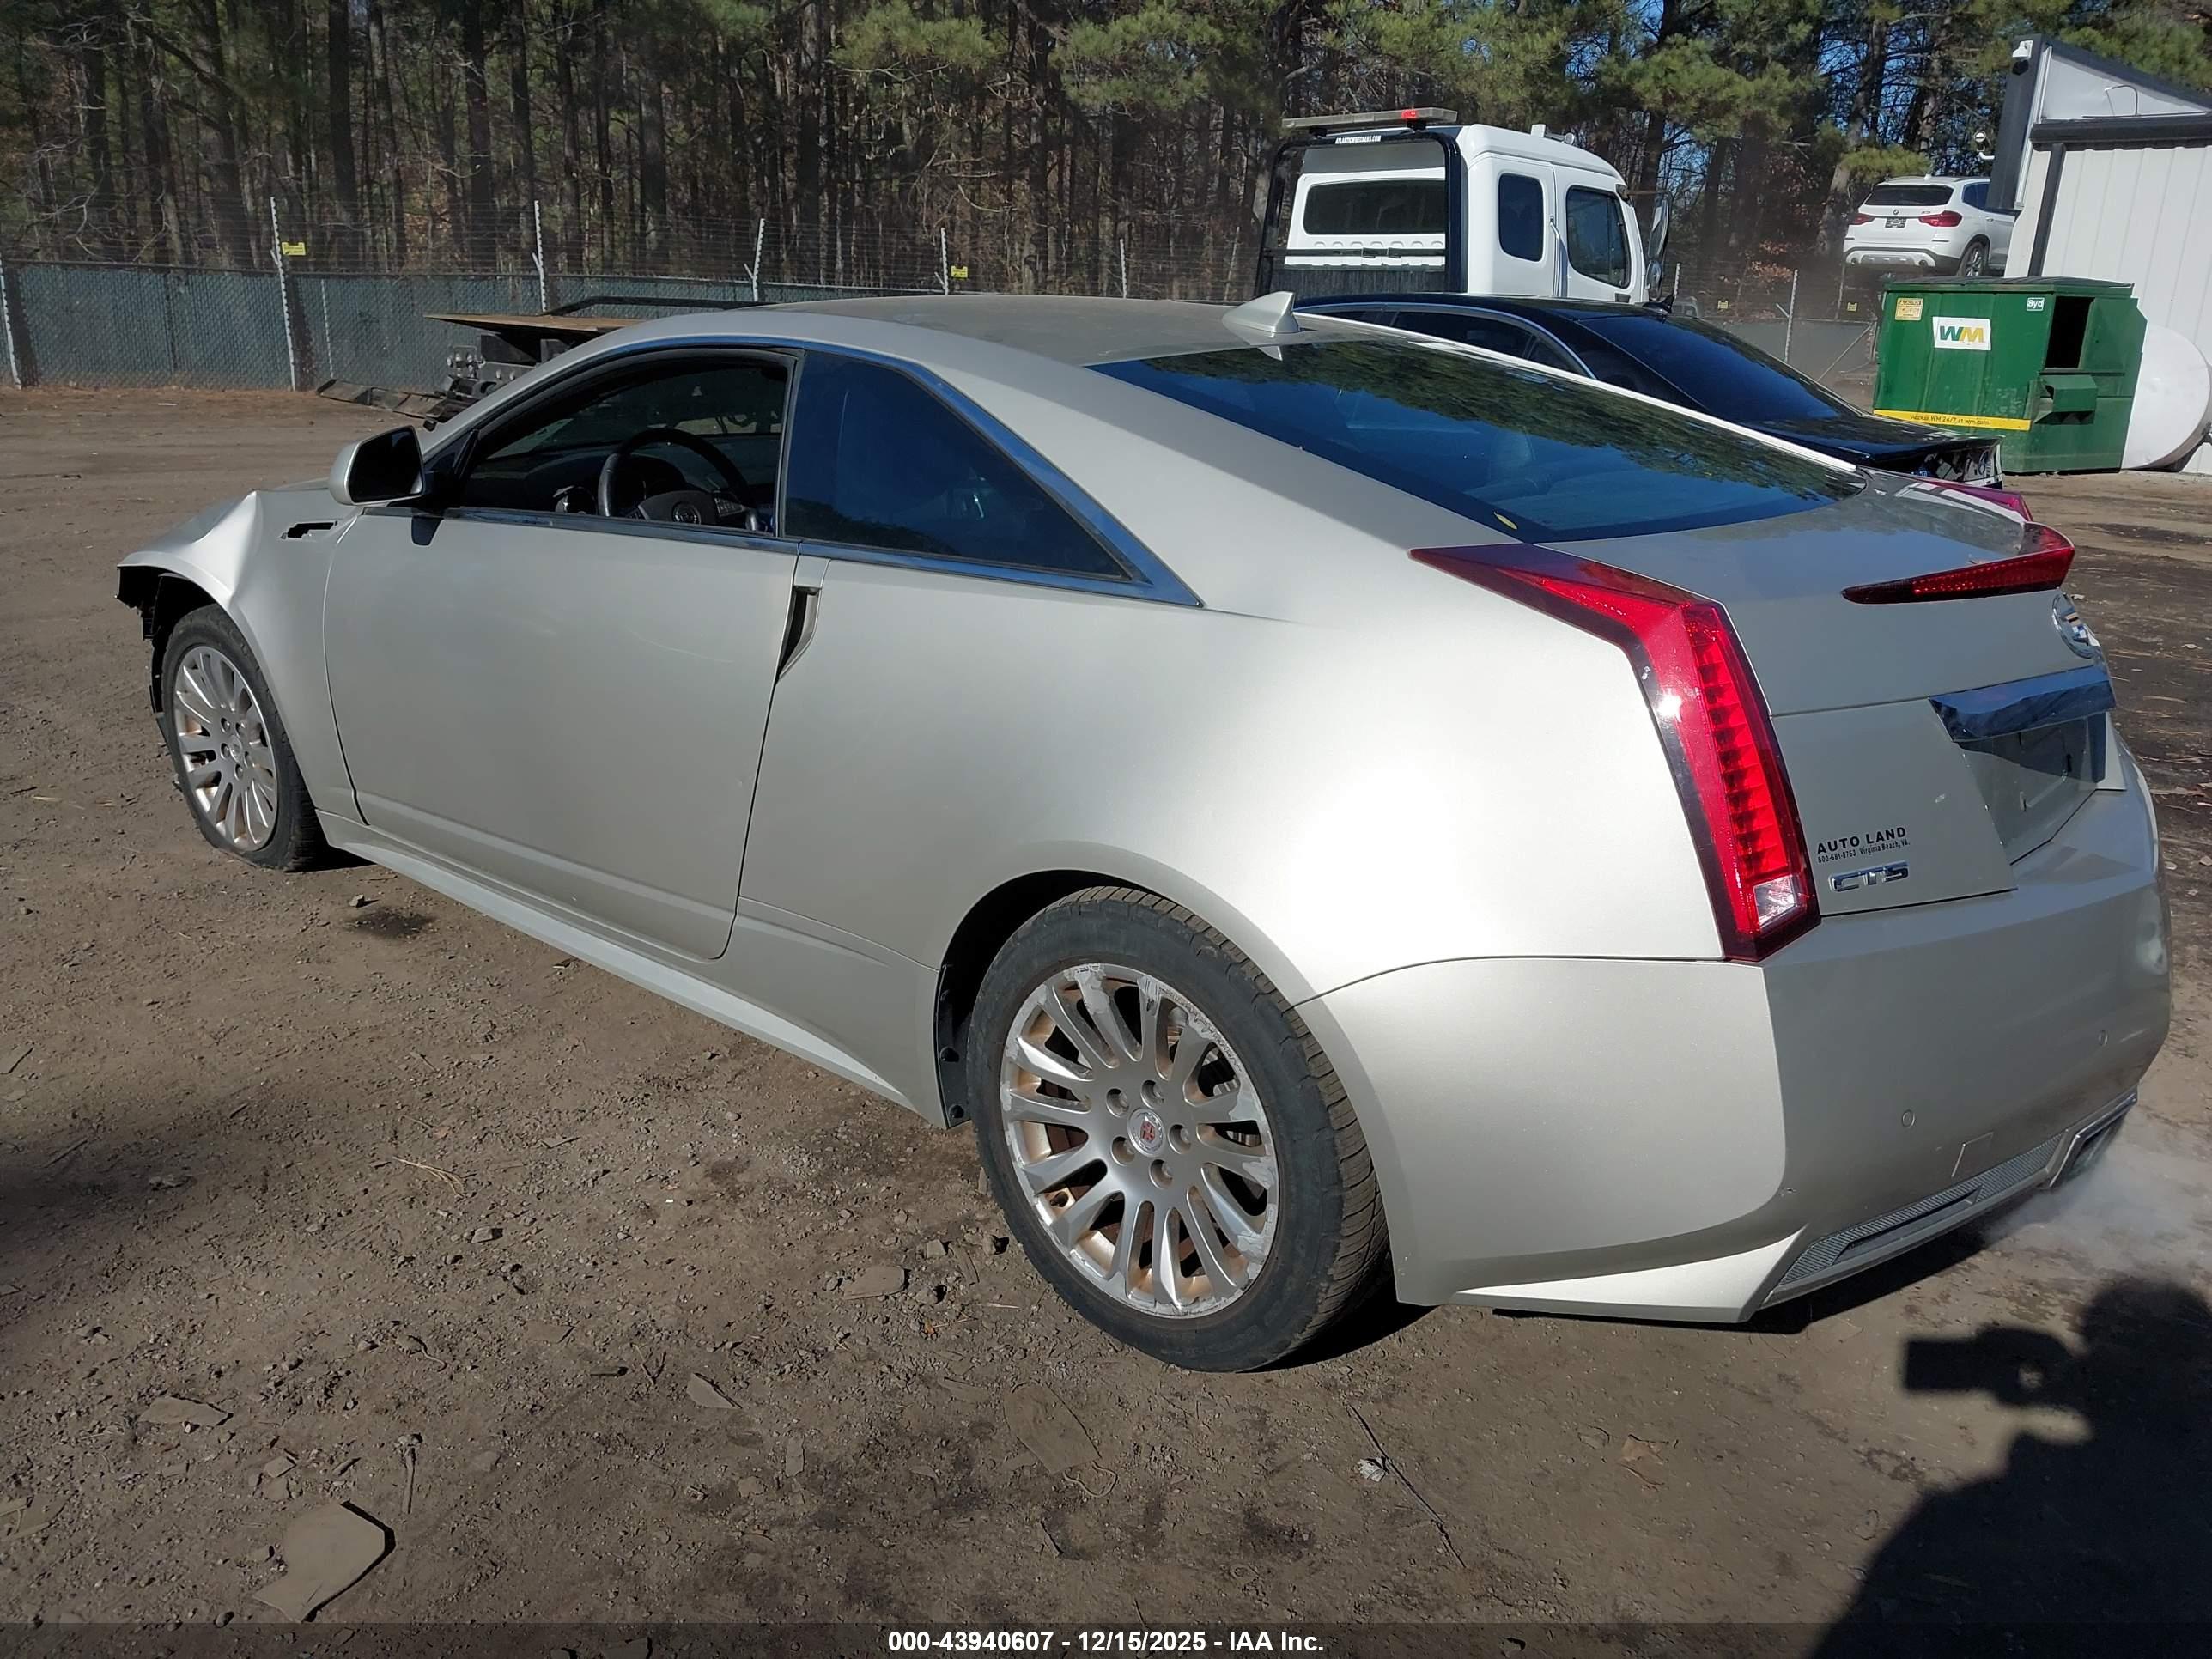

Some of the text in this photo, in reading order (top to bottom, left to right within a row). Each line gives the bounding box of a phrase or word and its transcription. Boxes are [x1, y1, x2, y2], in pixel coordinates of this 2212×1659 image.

[1939, 325, 1984, 343] WM
[1817, 827, 1905, 854] AUTO LAND
[1859, 844, 1881, 855] Virginia
[1828, 860, 1909, 892] CTS
